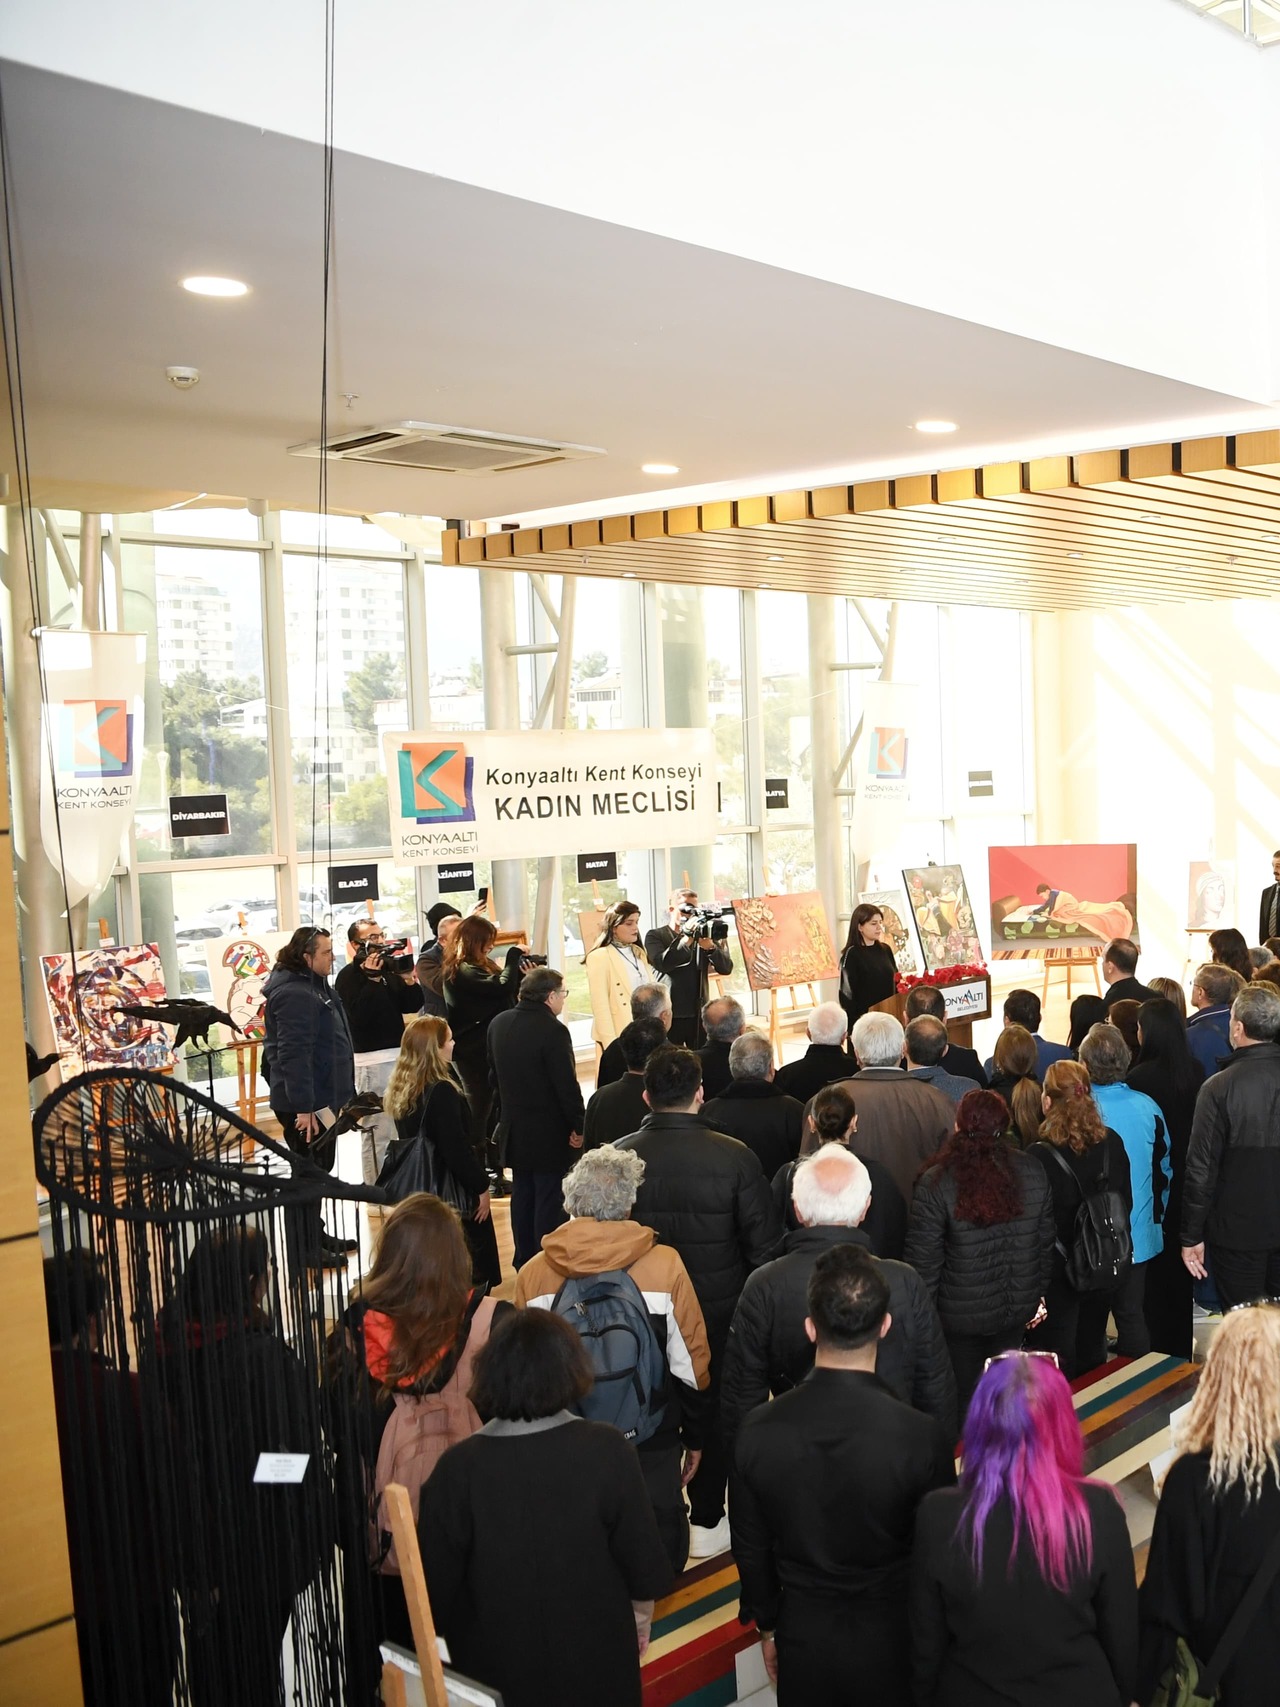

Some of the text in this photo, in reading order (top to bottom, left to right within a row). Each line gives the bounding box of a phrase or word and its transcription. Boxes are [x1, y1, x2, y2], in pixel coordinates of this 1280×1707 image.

[486, 762, 702, 788] Konyaaltı Kent Konseyi
[57, 785, 132, 798] KONYAALTI
[495, 784, 695, 821] KADIN MECLİSİ
[172, 811, 226, 821] DİYARBAKIR
[401, 831, 478, 846] KONYAALTI
[402, 848, 430, 858] KENT
[585, 860, 609, 869] HATAY
[437, 869, 473, 879] ZİANTEP
[338, 877, 369, 889] ELAZIĞ
[945, 989, 984, 1007] ONYAALTI
